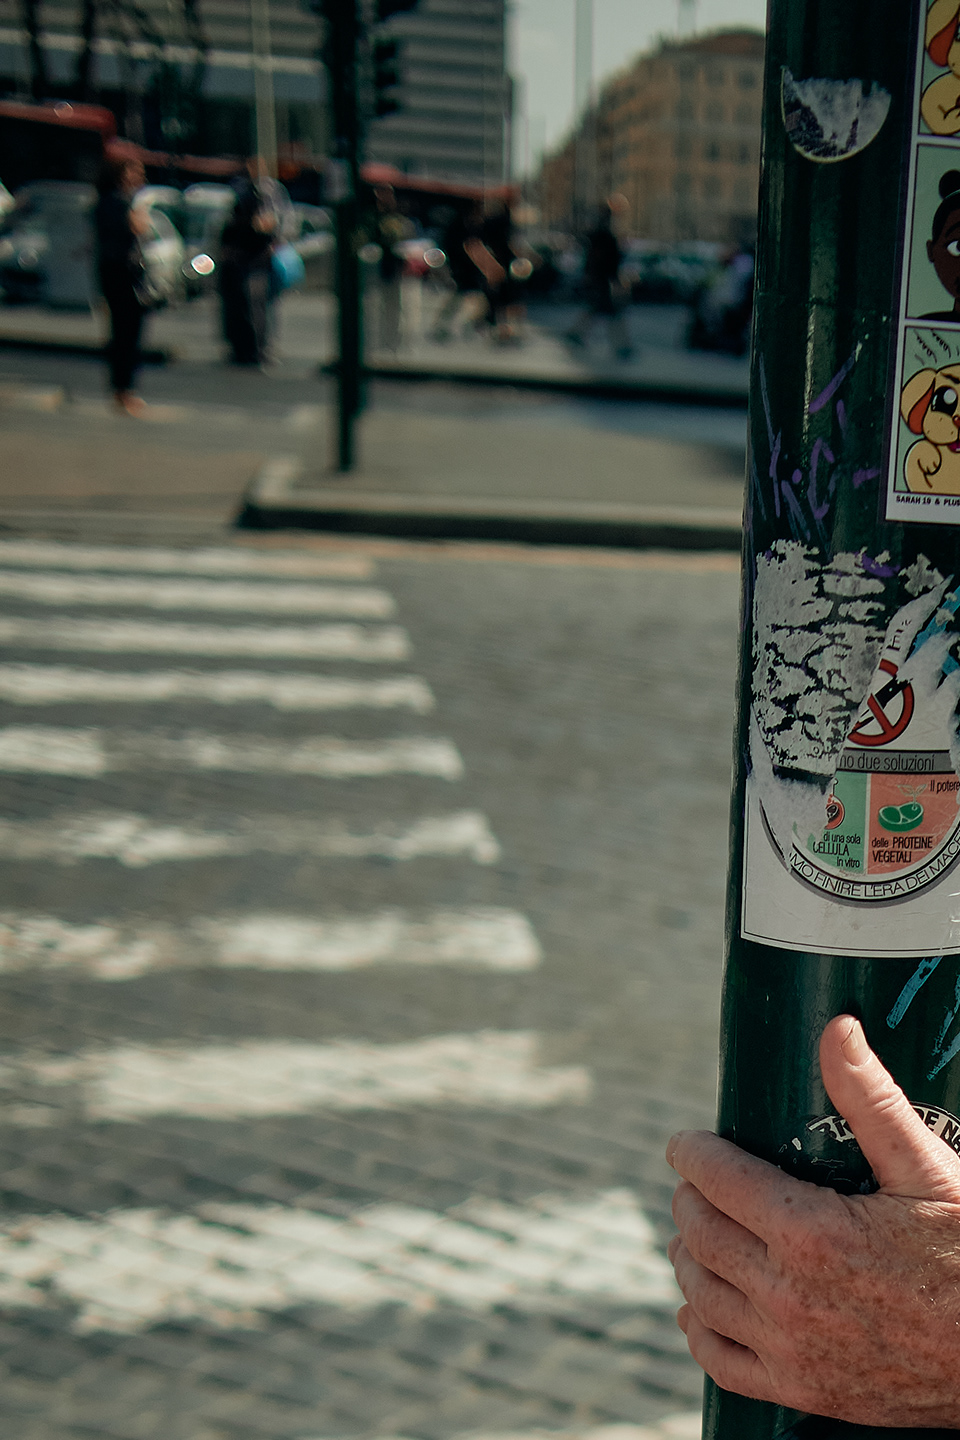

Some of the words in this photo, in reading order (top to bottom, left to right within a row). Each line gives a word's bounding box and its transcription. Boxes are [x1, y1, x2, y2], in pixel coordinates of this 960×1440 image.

[895, 495, 921, 505] SARAH
[857, 752, 881, 771] due
[883, 754, 935, 771] soluzioni
[929, 779, 935, 792] Il
[936, 781, 960, 794] potere
[823, 831, 830, 842] di
[832, 834, 845, 843] una
[846, 833, 861, 844] sola
[872, 836, 889, 848] delle
[892, 836, 933, 848] PROTEINE
[812, 841, 850, 856] CELLULA
[837, 856, 843, 867] in
[845, 856, 860, 868] vitro
[872, 850, 912, 863] VEGETALI
[789, 853, 814, 877] MO
[814, 872, 861, 897] FINIRE
[864, 881, 904, 898] L'ERA
[906, 869, 930, 891] DEI
